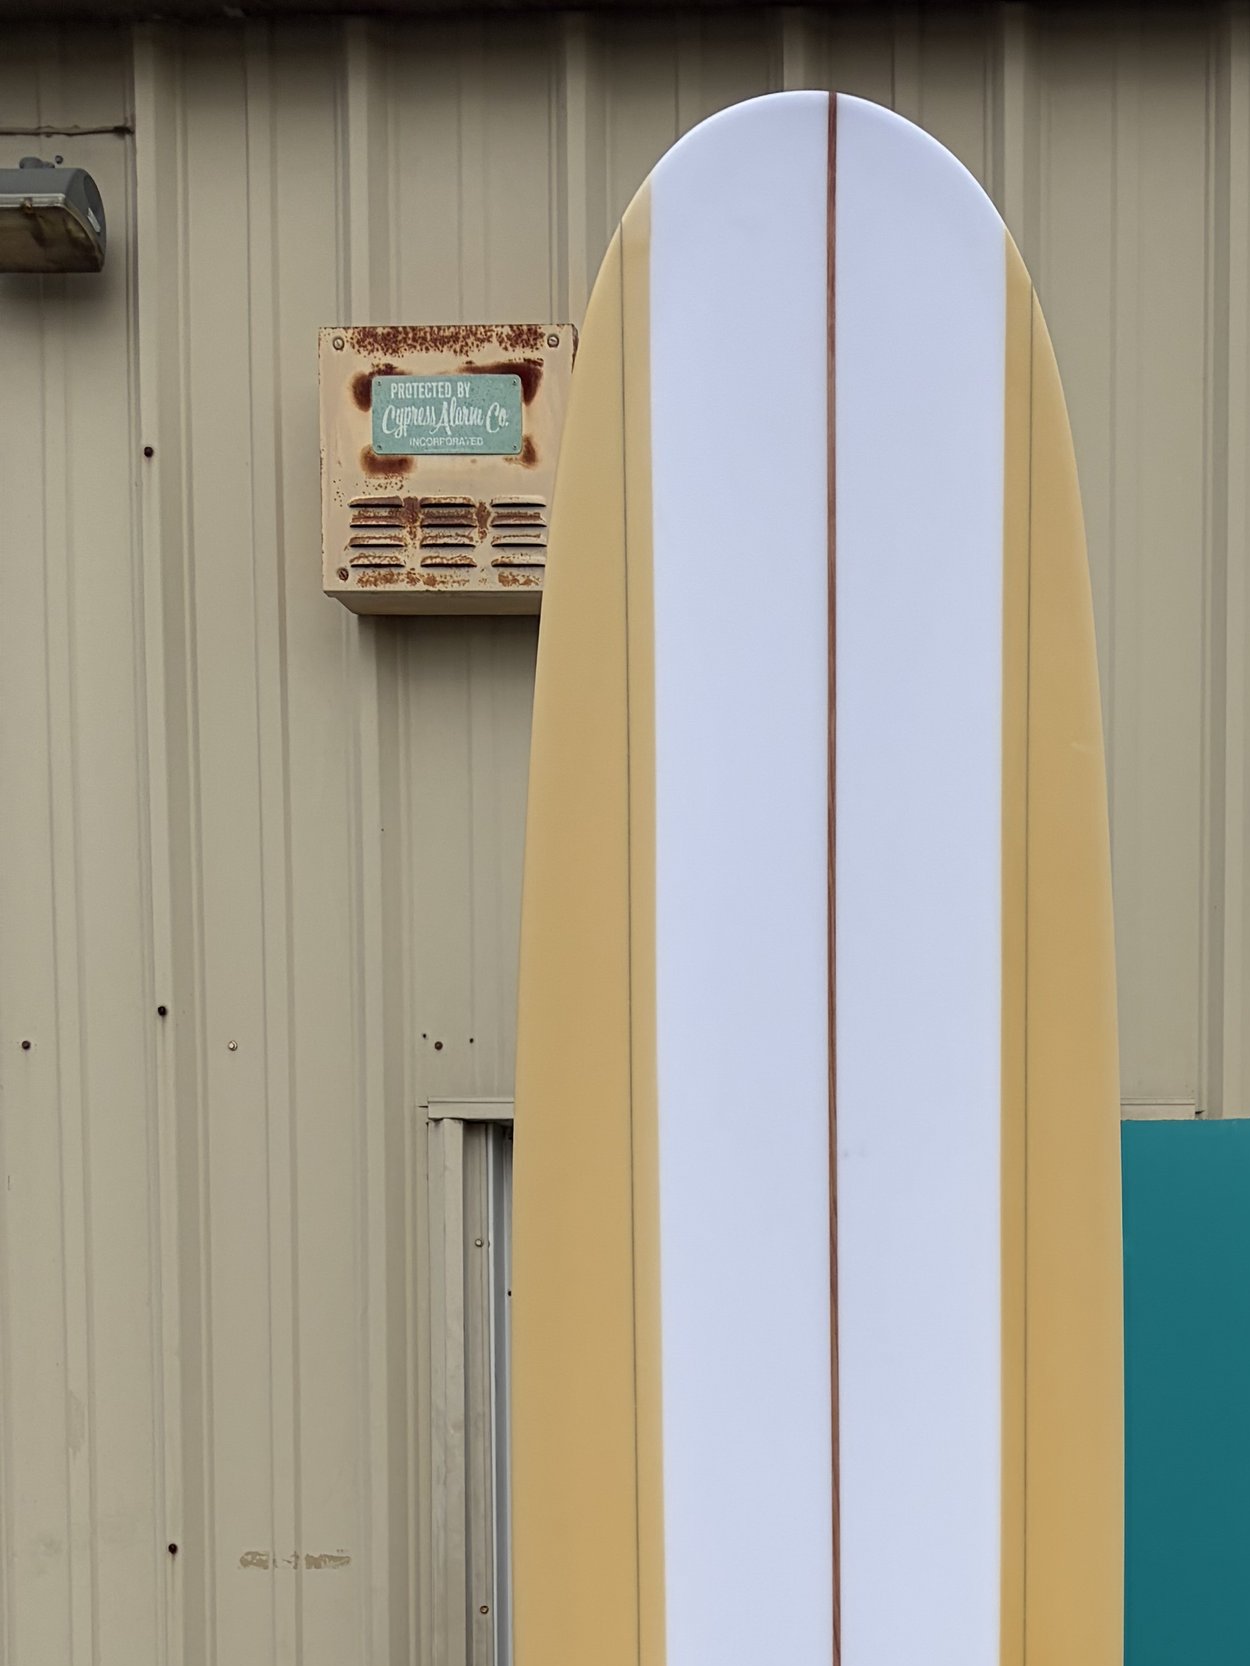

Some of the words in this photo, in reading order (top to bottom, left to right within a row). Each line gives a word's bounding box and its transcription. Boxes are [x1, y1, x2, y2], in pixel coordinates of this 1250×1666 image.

[391, 381, 452, 399] PROTECTED
[457, 381, 471, 398] BY
[383, 405, 435, 438] Cypress
[430, 397, 485, 434] Alarm
[486, 401, 509, 433] Co.
[409, 436, 484, 447] INCORPORATED
